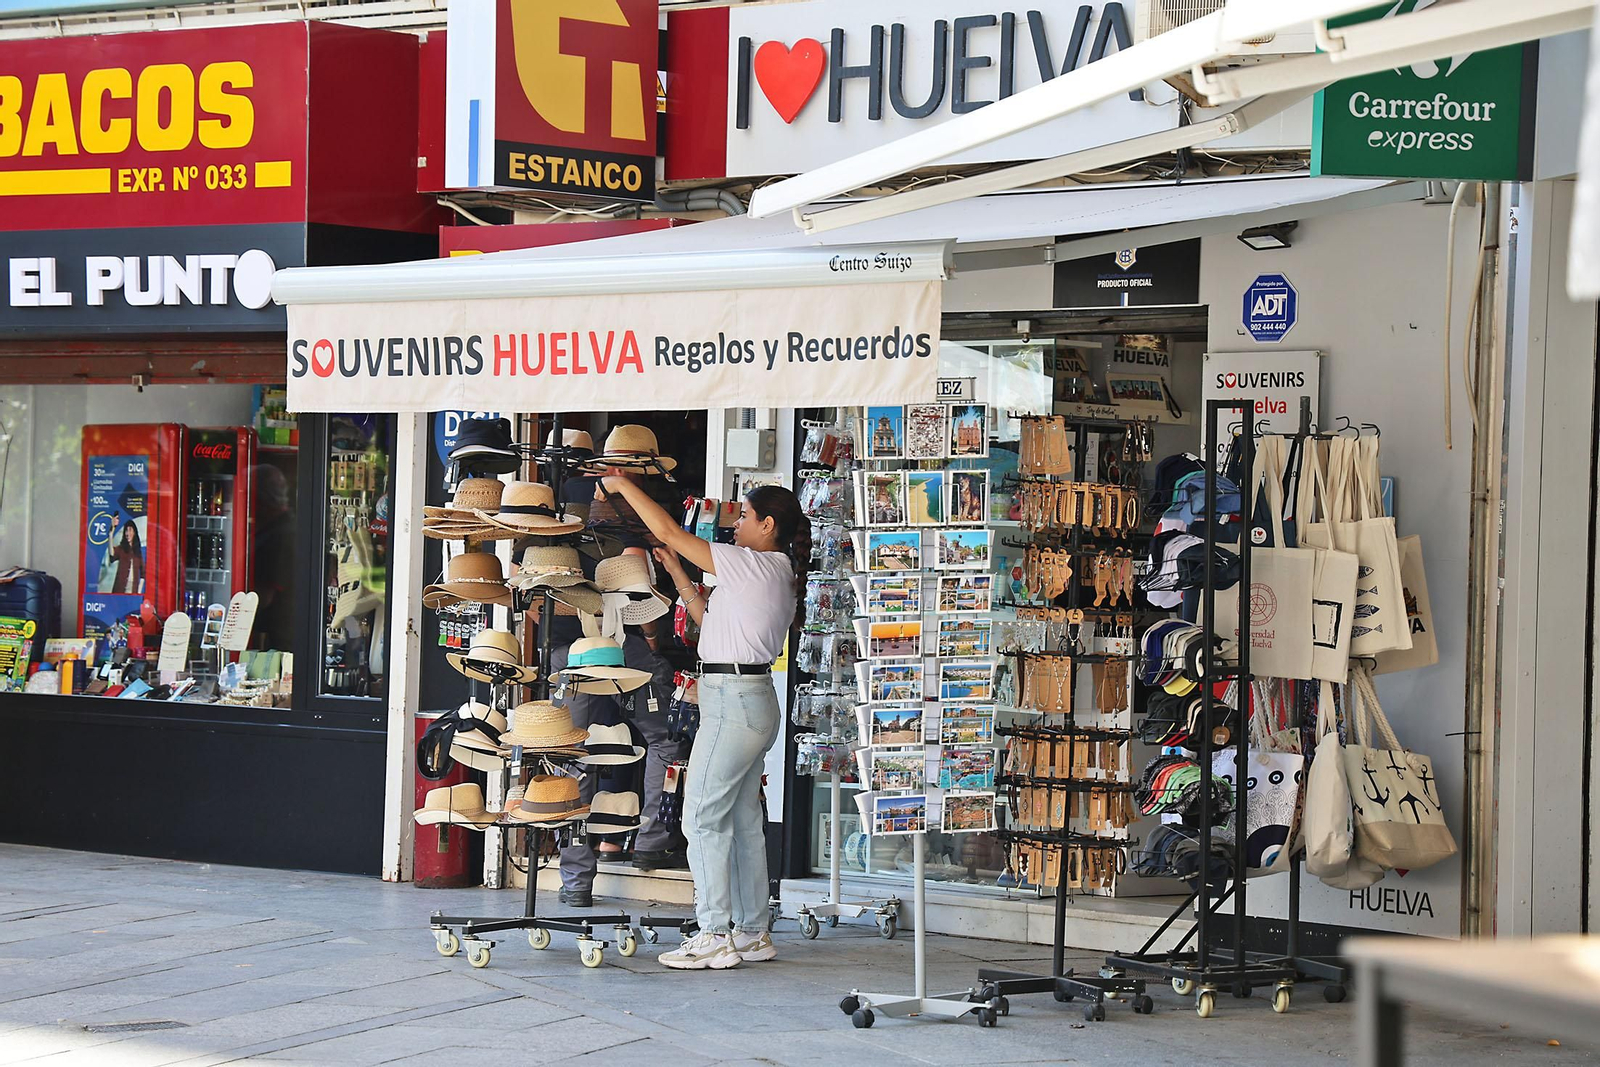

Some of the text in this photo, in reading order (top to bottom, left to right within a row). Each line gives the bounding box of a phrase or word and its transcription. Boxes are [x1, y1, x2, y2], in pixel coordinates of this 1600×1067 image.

[1348, 91, 1496, 122] Carrefour
[1367, 127, 1475, 154] express
[117, 168, 165, 193] EXP.
[205, 163, 247, 190] 033
[508, 152, 643, 192] ESTANCO
[828, 252, 913, 272] Centro Suizo
[9, 248, 277, 310] EL PUNTO
[1097, 279, 1153, 288] PRODUCTO OFICIAL
[1251, 294, 1287, 316] ADT
[292, 325, 932, 378] SOUVENIRS HUELVA Regalos y Recuerdos
[1113, 349, 1169, 367] HUELVA
[1043, 356, 1083, 373] UELVA
[937, 381, 962, 395] EZ
[1216, 371, 1305, 389] SOUVENIRS
[128, 463, 144, 473] DIGI
[86, 602, 101, 612] DIGI
[1349, 887, 1434, 918] HUELVA
